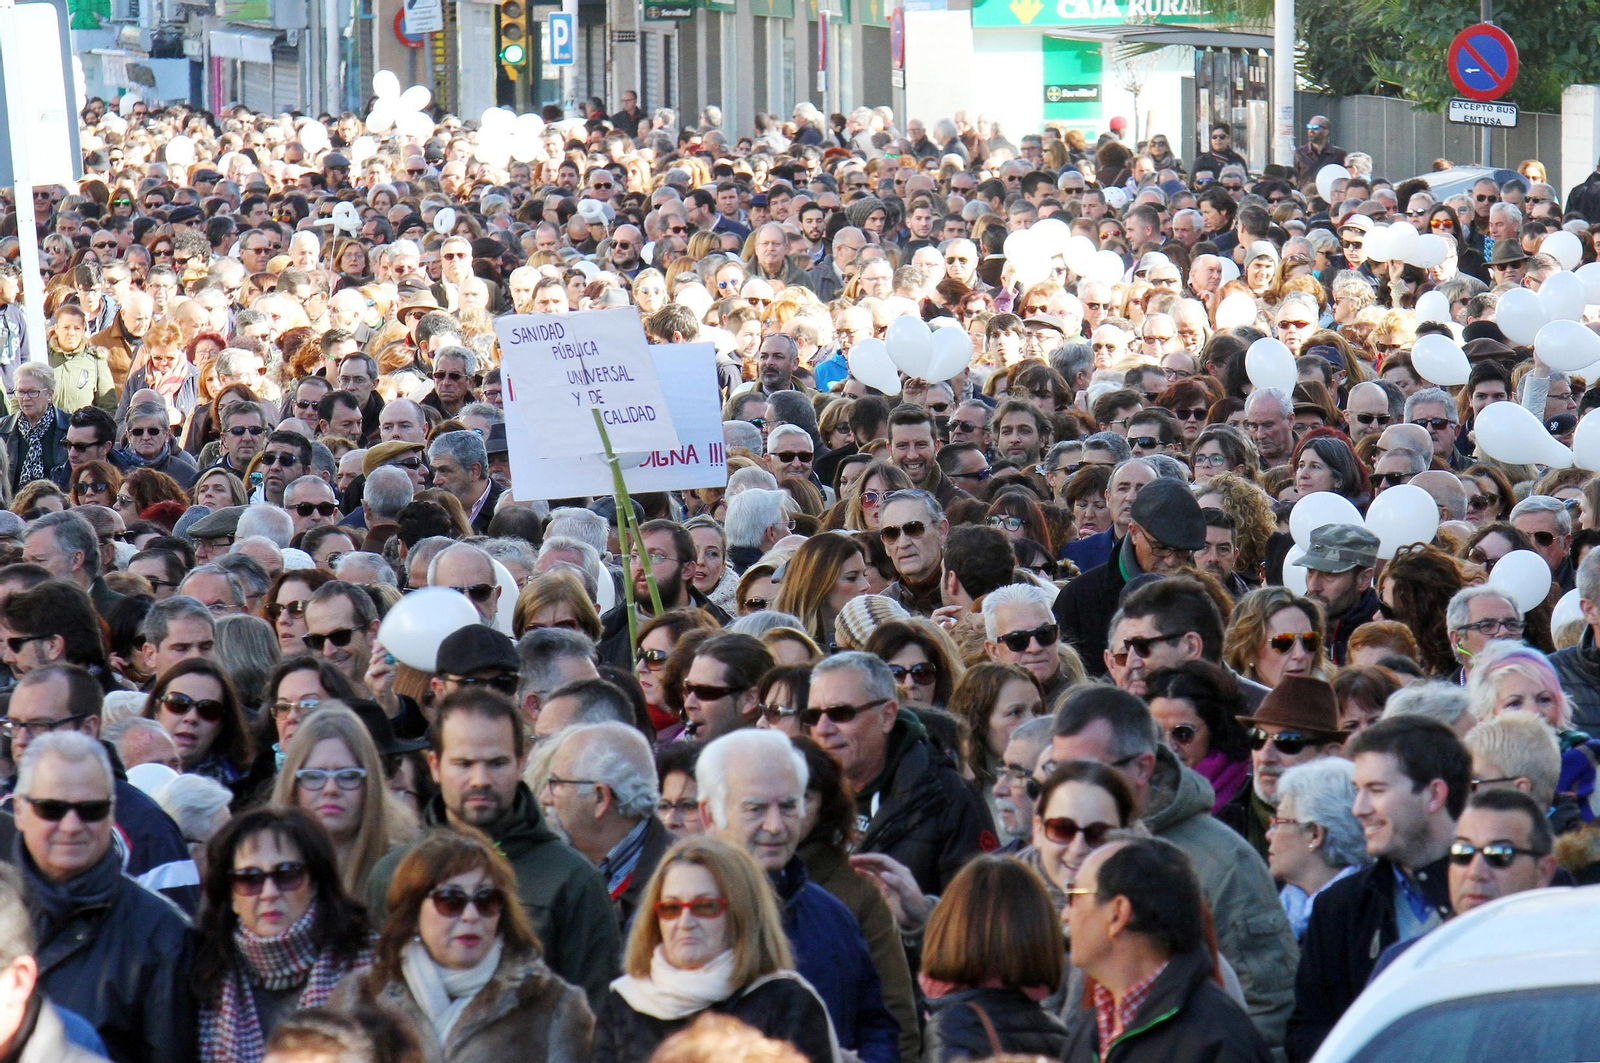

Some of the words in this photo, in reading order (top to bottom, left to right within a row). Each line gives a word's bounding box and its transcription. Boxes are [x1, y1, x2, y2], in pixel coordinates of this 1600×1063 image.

[553, 19, 569, 59] P
[1451, 102, 1493, 112] EXCEPTO
[1496, 105, 1515, 114] BUS
[1464, 115, 1502, 125] EMTUSA
[510, 322, 565, 345] SANIDAD
[551, 340, 600, 361] PÚBLICA
[566, 364, 635, 386] UNIVERSAL
[571, 392, 581, 407] Y
[588, 389, 606, 405] DE
[603, 405, 657, 425] CALIDAD
